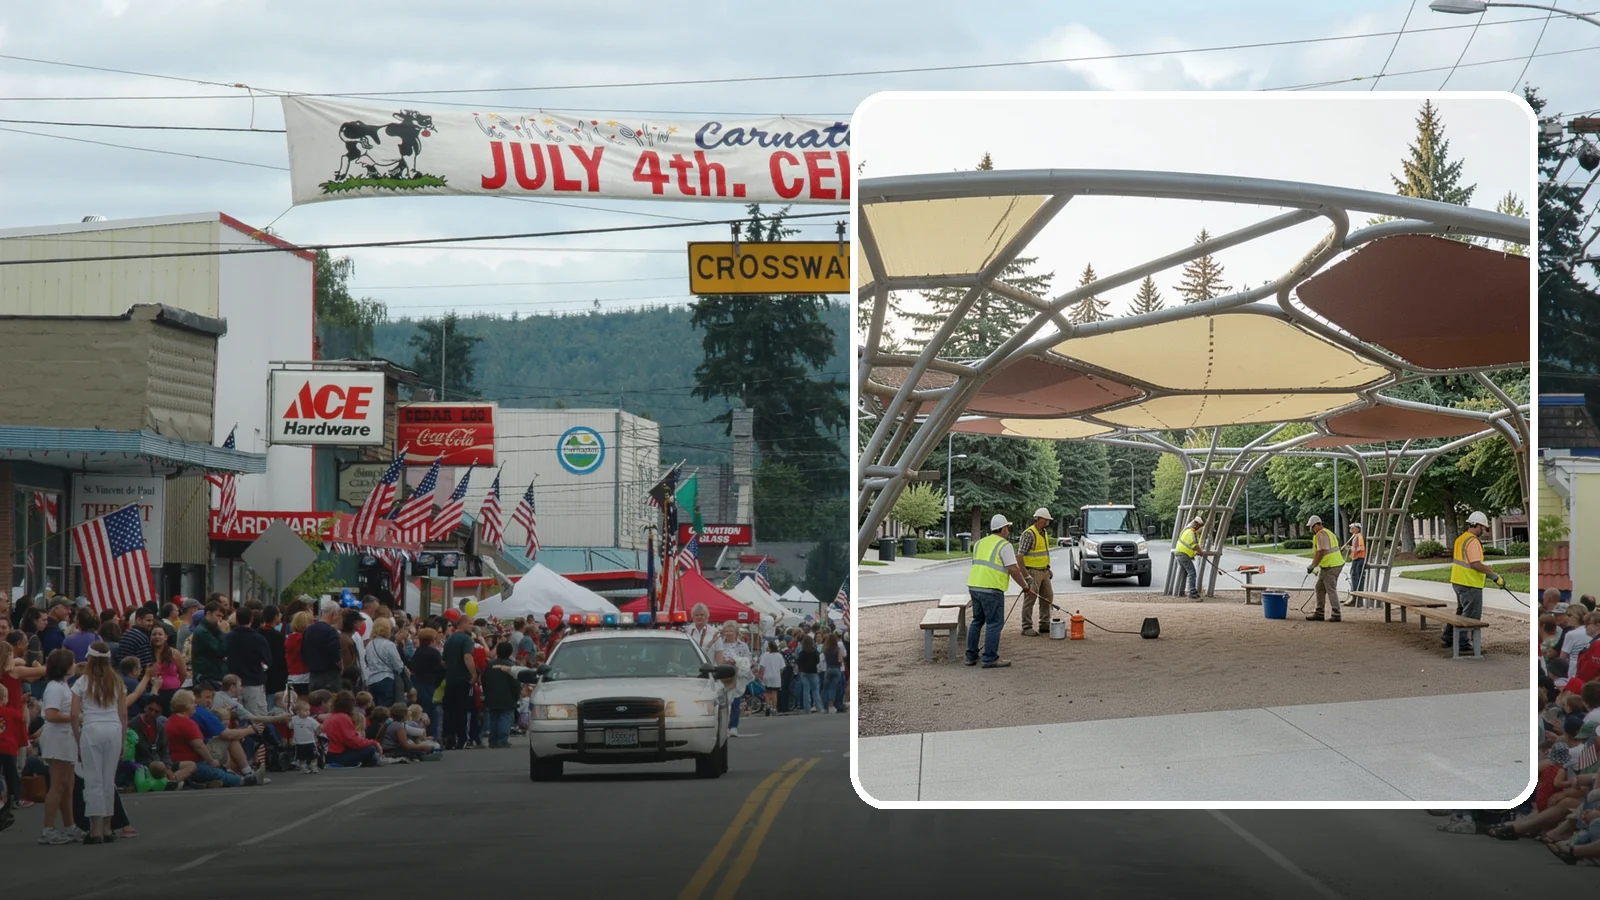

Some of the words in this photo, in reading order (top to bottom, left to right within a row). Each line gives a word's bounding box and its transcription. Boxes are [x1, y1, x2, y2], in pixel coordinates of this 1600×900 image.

[481, 141, 604, 192] JULY
[632, 150, 746, 198] 4th.
[697, 254, 850, 280] CROSSWA
[282, 380, 373, 420] ACE
[406, 410, 452, 422] CEDAR
[462, 410, 484, 421] LOG
[283, 421, 370, 436] Hardware
[353, 467, 386, 481] Simpl
[83, 485, 93, 494] St.
[96, 485, 124, 494] Vincent
[126, 486, 136, 494] de
[138, 486, 155, 495] Paul
[81, 503, 153, 522] THRT
[688, 526, 741, 535] CRNATION
[699, 535, 730, 543] GLASS
